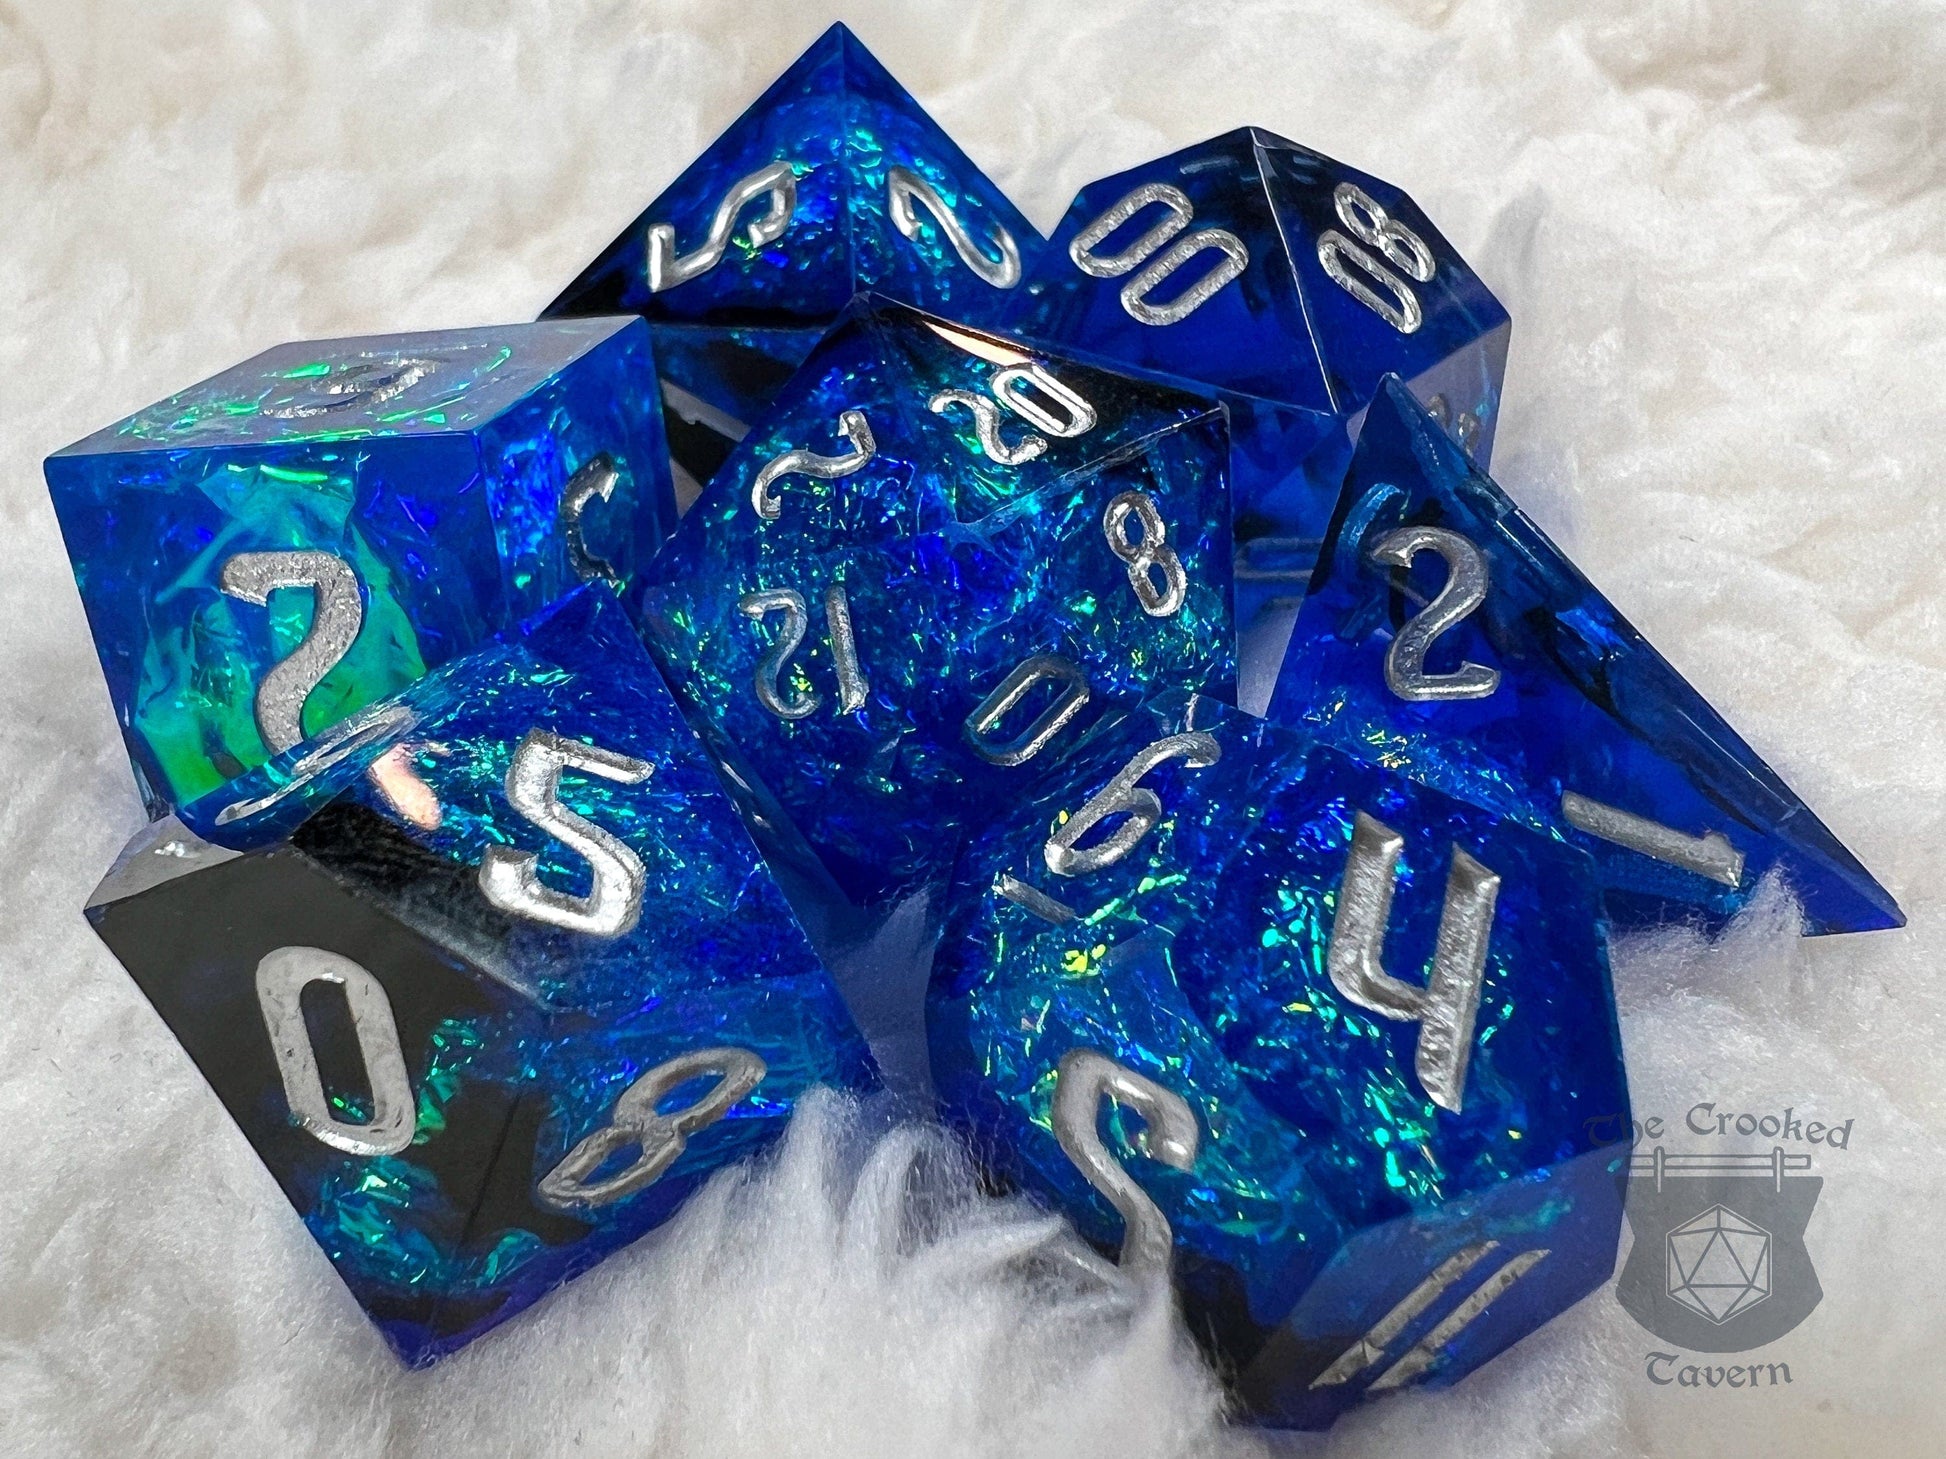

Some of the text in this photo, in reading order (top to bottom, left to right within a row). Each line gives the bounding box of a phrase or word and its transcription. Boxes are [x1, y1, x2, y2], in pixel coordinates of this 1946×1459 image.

[1069, 183, 1249, 325] 00
[929, 364, 1097, 465] 20
[1104, 490, 1186, 616] 8
[1370, 526, 1500, 701] 2
[478, 726, 654, 936] 5
[1045, 732, 1222, 877] 6
[1328, 810, 1500, 1114] 4
[256, 946, 417, 1156] 0
[538, 1046, 767, 1209] 8
